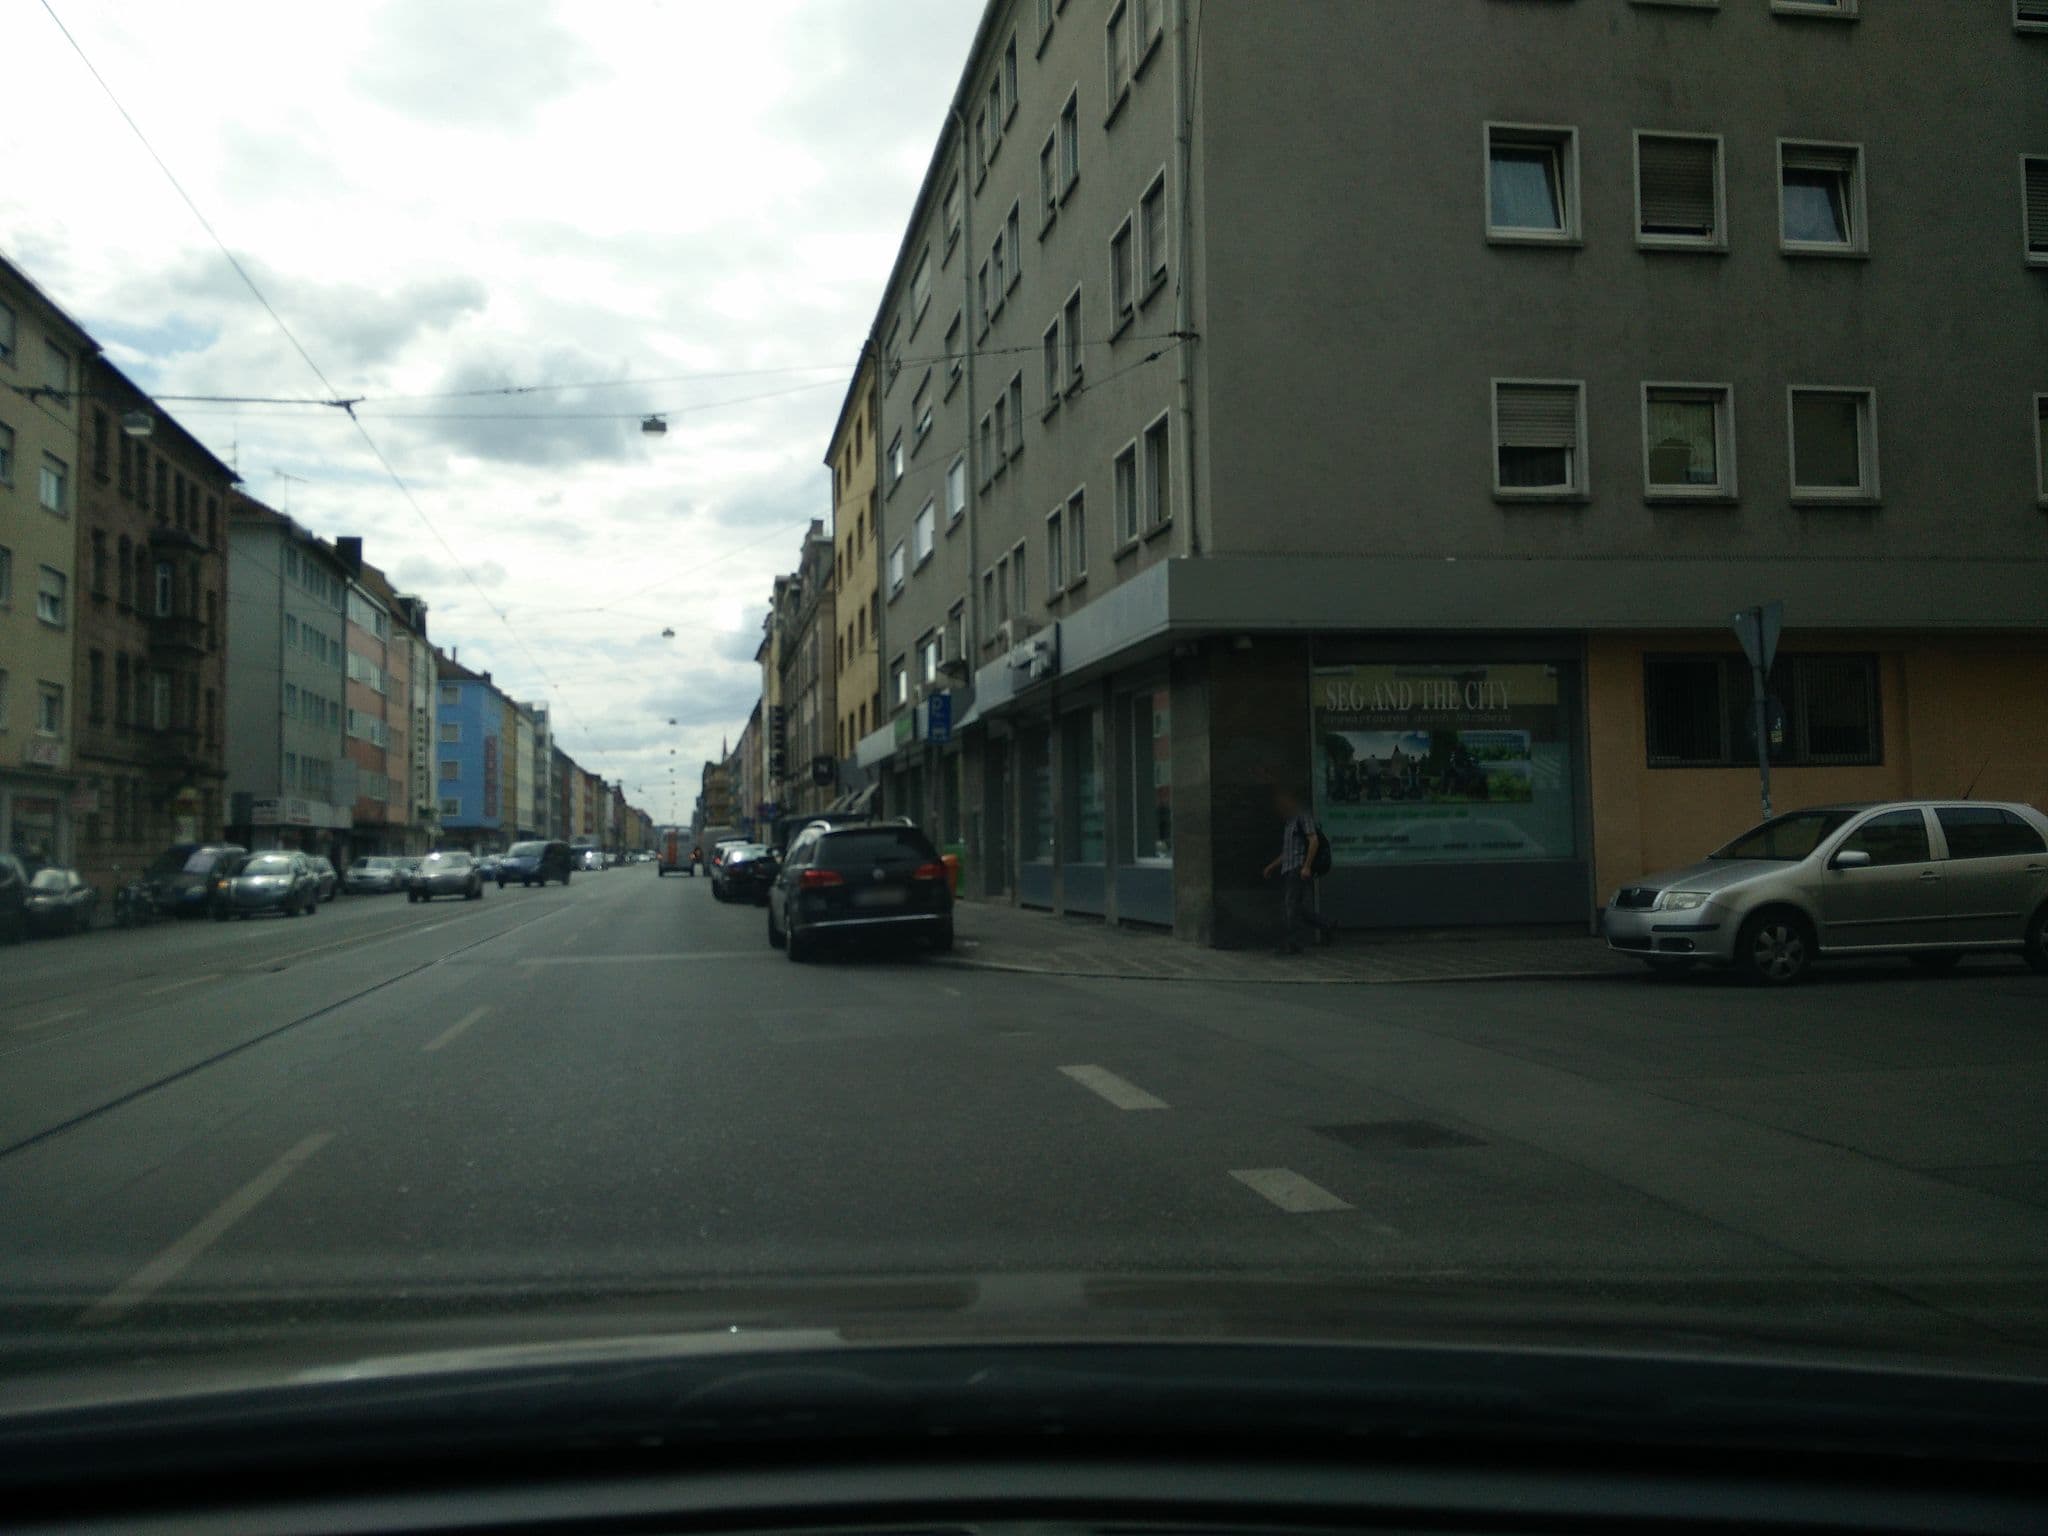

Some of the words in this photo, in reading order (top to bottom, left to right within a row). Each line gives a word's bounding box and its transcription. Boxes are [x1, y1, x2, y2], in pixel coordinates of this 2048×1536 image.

[1326, 681, 1364, 711] SEG
[1370, 681, 1412, 711] AND
[1419, 681, 1460, 710] THE
[1465, 680, 1511, 710] CITY
